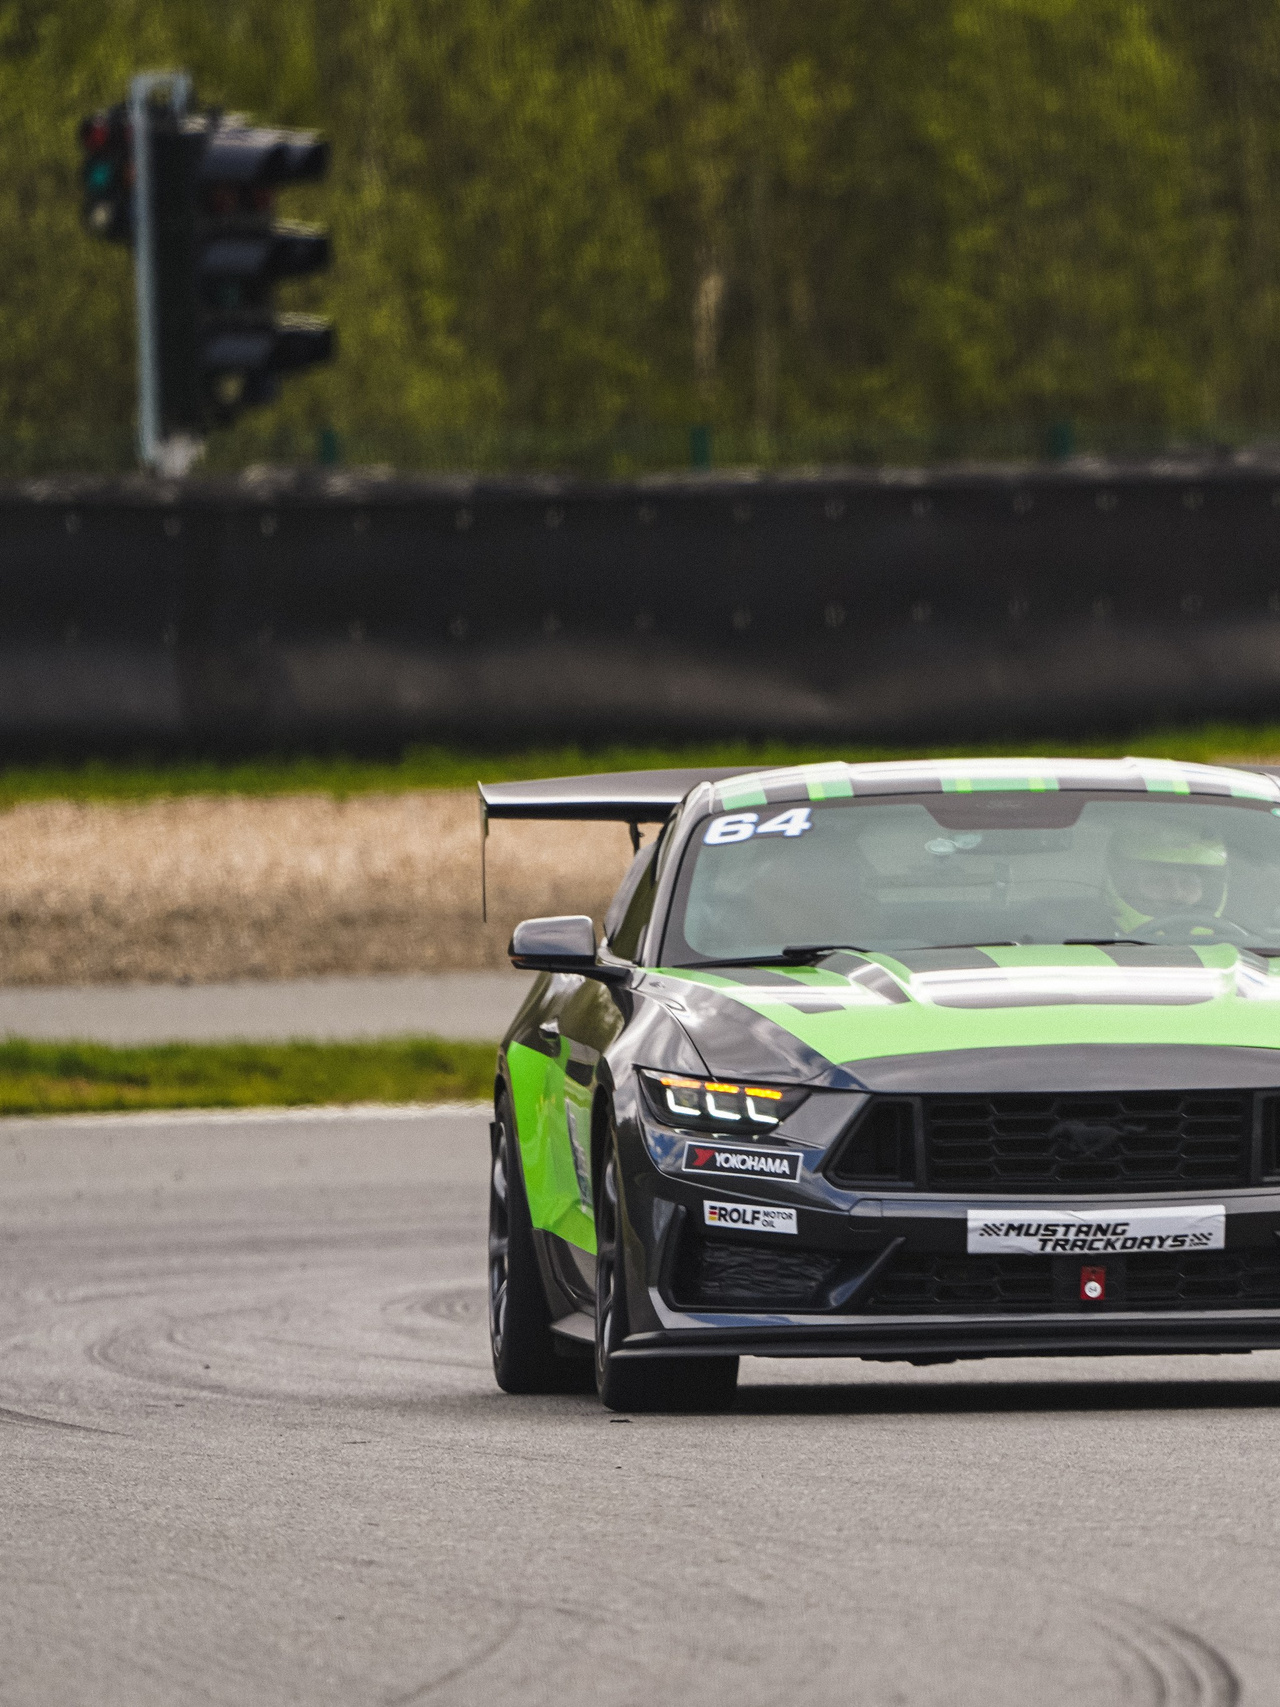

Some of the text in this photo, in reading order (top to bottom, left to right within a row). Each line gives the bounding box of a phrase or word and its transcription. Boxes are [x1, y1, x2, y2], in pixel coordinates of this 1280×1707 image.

[703, 808, 812, 845] 64
[715, 1152, 790, 1175] YOKOHAMA
[718, 1207, 761, 1225] ROLF
[762, 1210, 793, 1220] MOTOR
[762, 1220, 776, 1228] OIL
[1004, 1222, 1130, 1237] MUSTANG
[1038, 1234, 1188, 1251] TRACKDAYS
